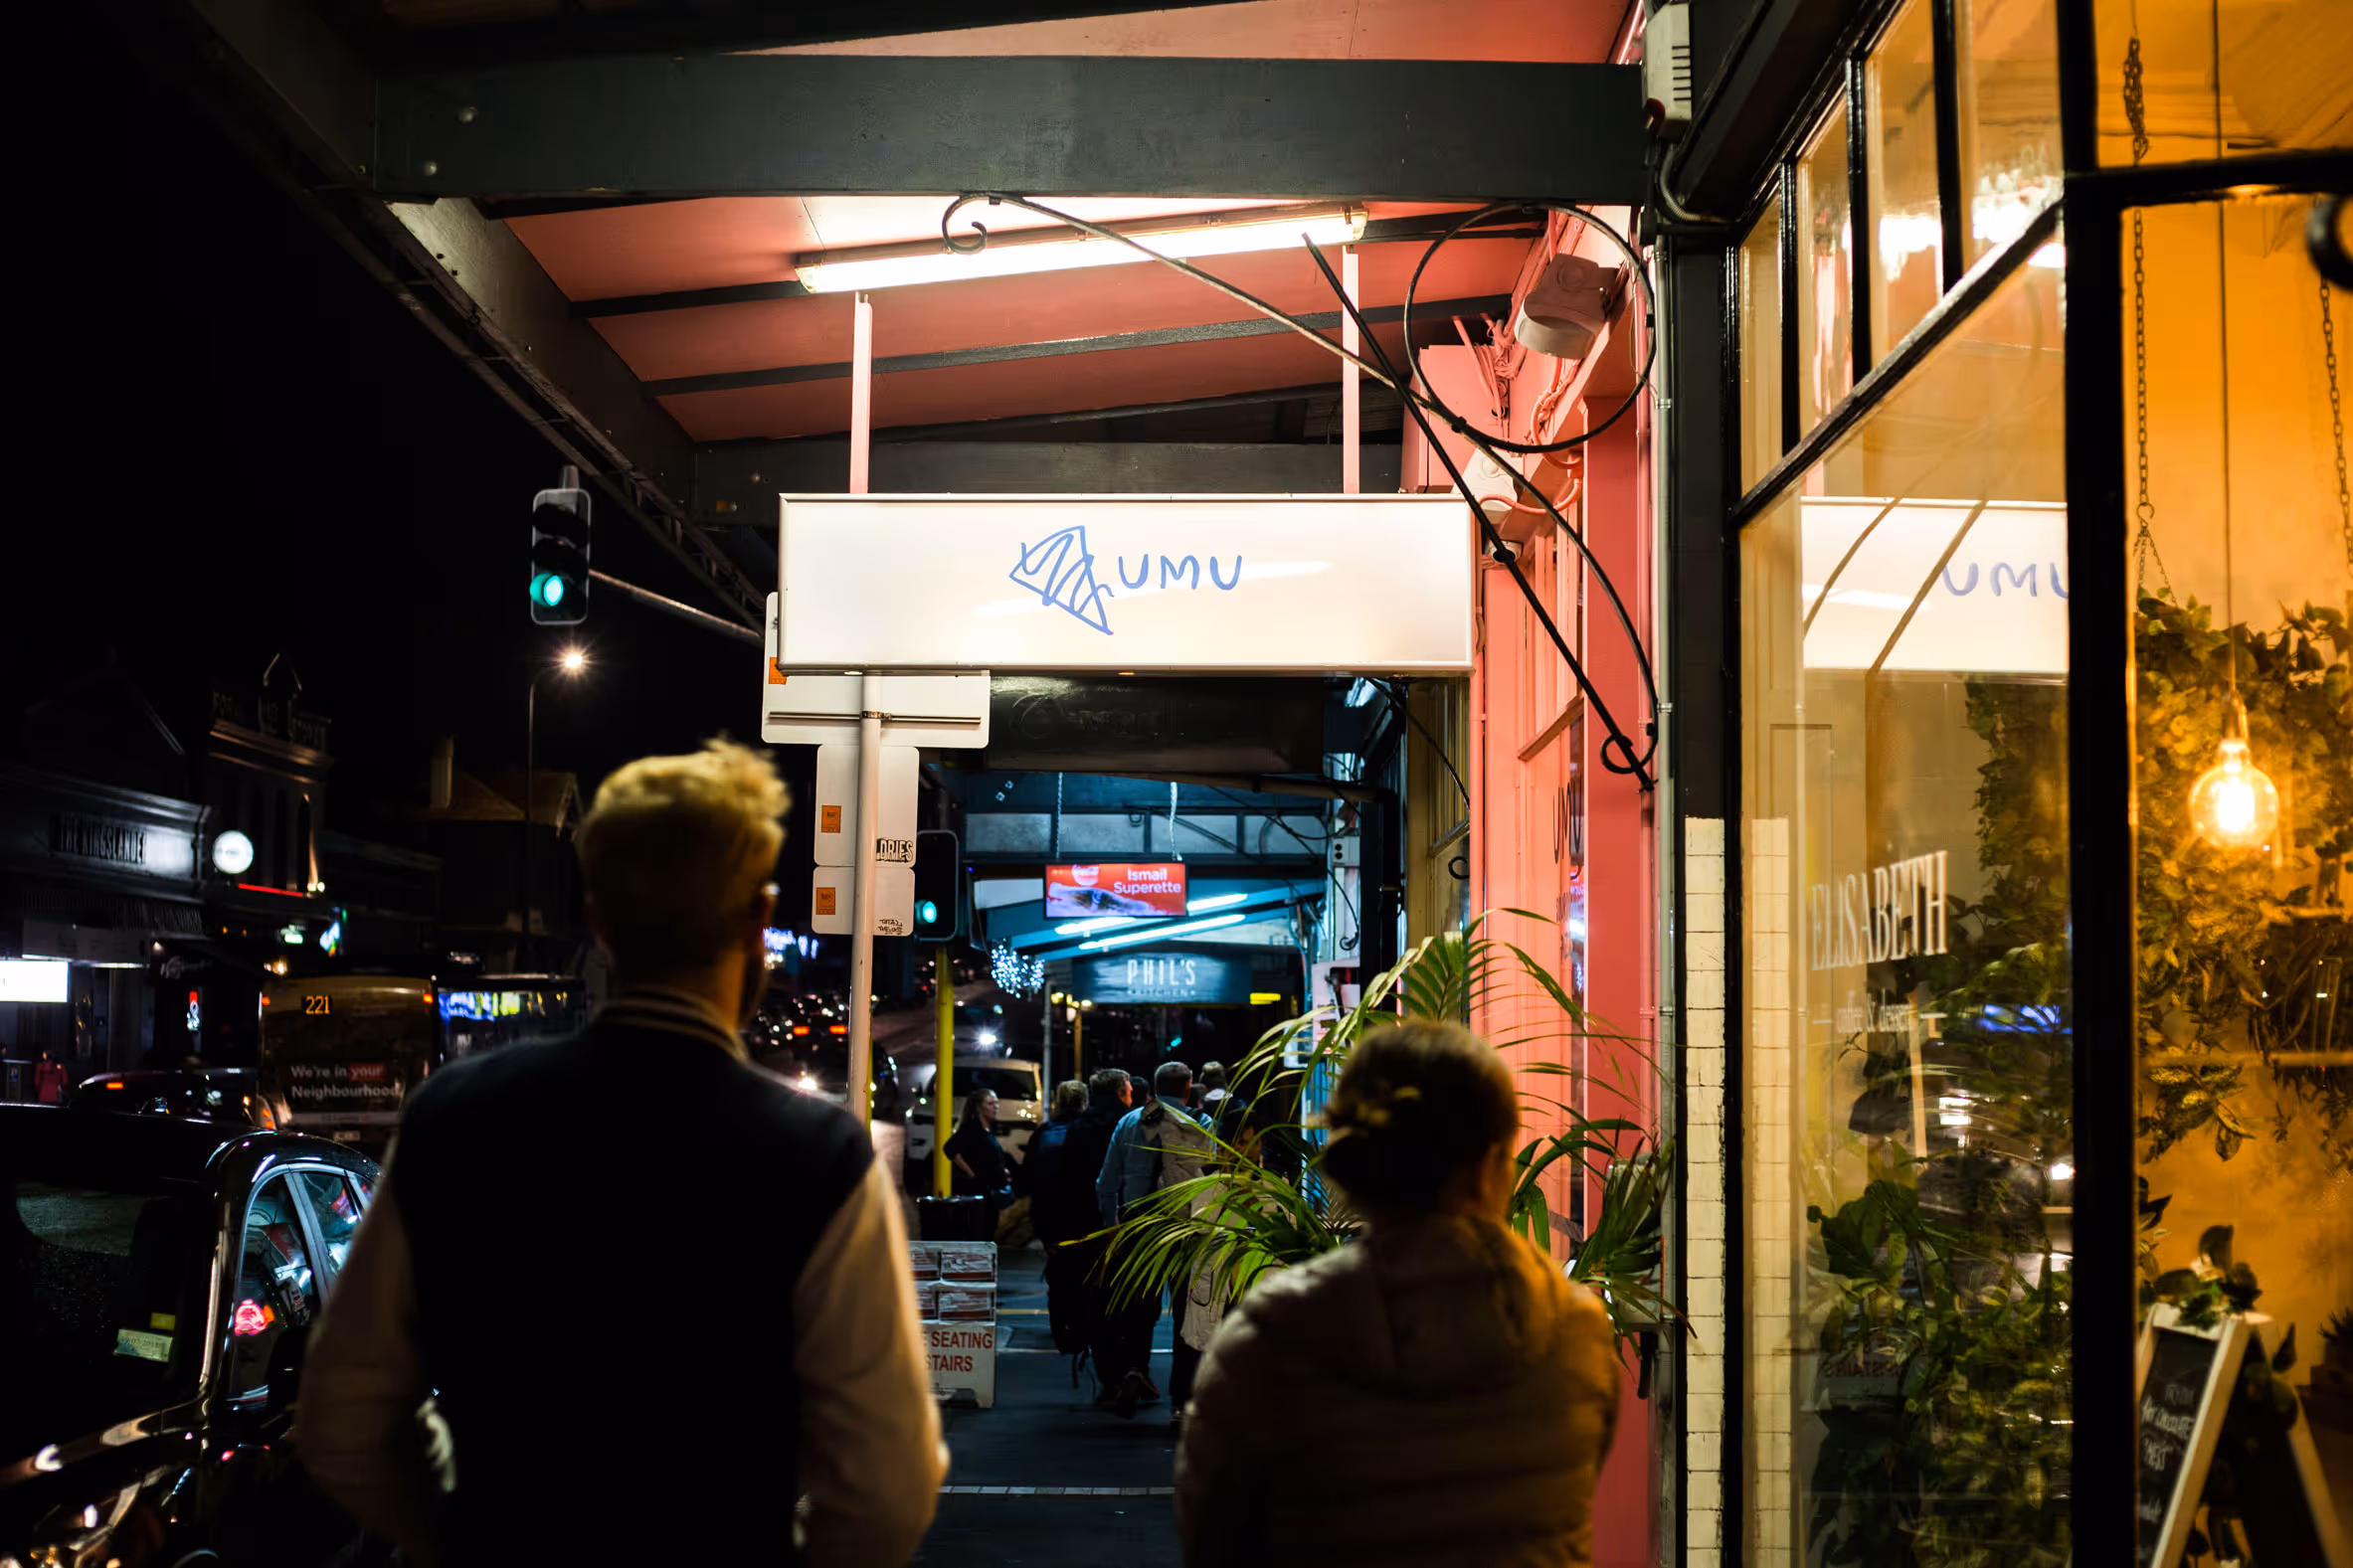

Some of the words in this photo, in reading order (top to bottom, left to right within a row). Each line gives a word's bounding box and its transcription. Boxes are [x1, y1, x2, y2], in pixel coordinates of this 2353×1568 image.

[1118, 553, 1243, 592] UMU
[83, 816, 149, 864] KINGSLANDE
[1127, 868, 1168, 881] Ismail
[1113, 881, 1182, 895] Superette
[1811, 851, 1949, 971] ELISABETH
[1127, 959, 1195, 985] PHIL'S
[304, 995, 330, 1014] 221
[290, 1066, 331, 1078] We're
[334, 1065, 347, 1078] in
[349, 1066, 383, 1082] your
[931, 1331, 994, 1349] SEATING
